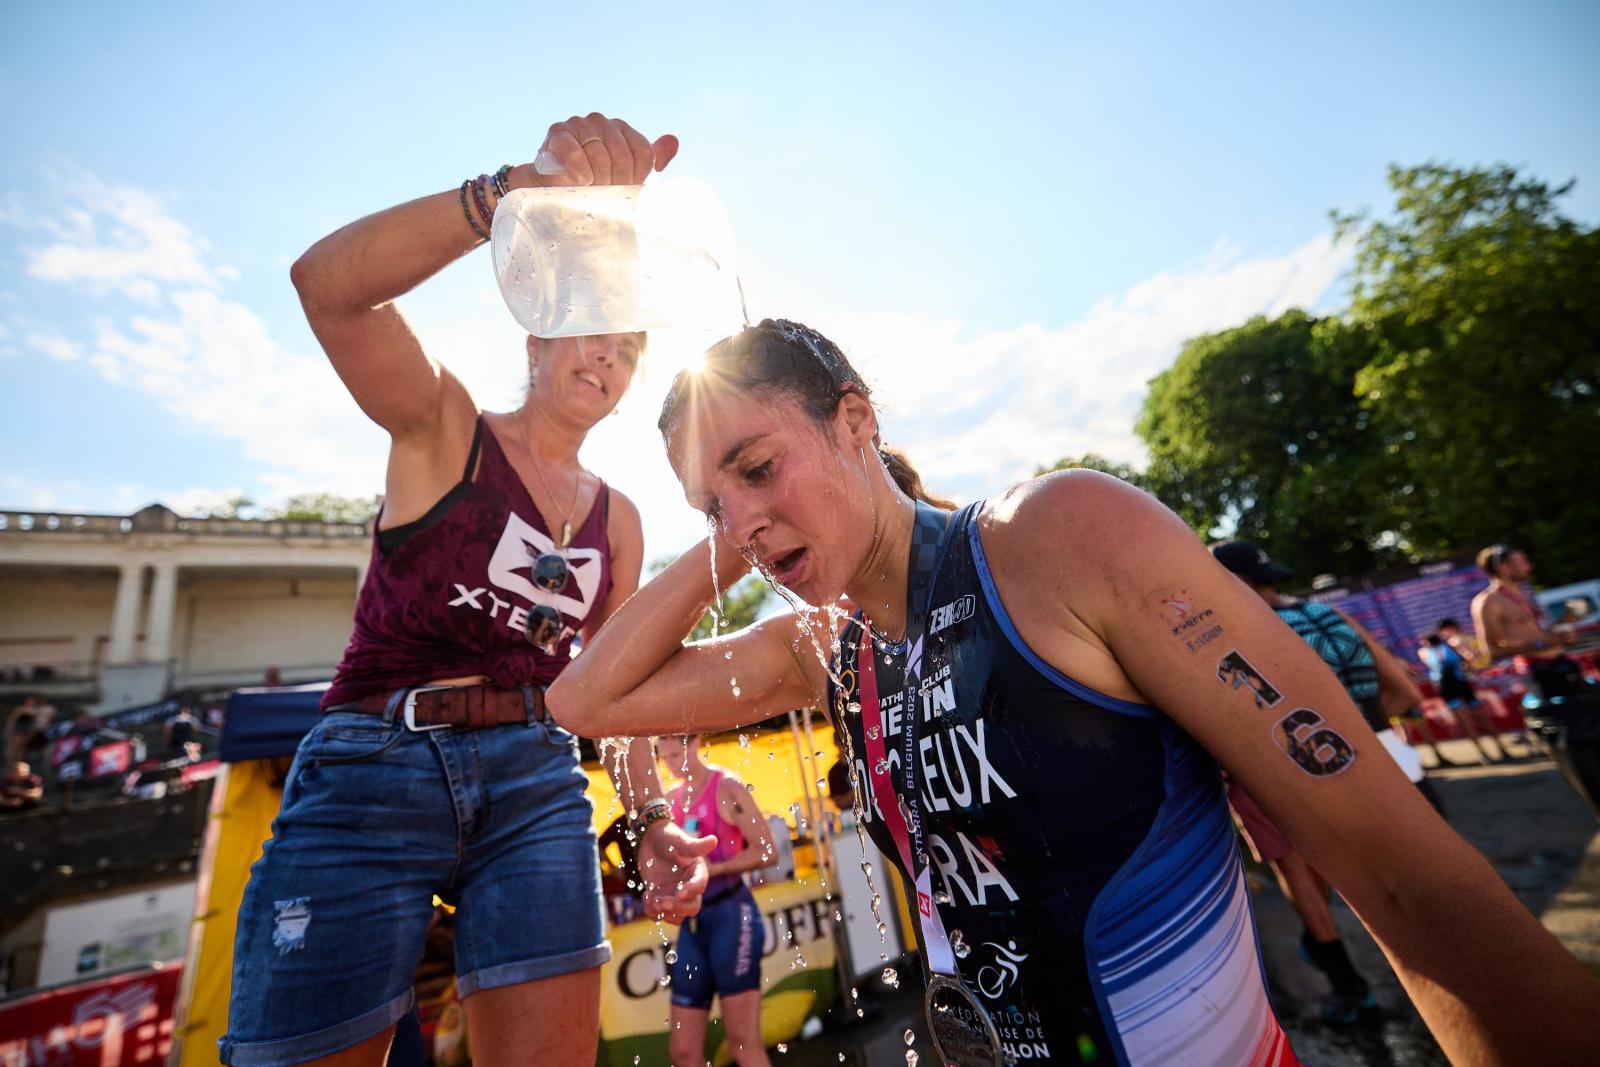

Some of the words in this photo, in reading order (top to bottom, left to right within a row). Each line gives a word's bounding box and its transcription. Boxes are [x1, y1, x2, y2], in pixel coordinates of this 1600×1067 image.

[448, 583, 576, 643] XTE
[921, 664, 951, 689] CLUB
[907, 686, 916, 721] 2023
[905, 725, 915, 790] BELGIUM
[928, 831, 1020, 907] RA
[1025, 1027, 1045, 1040] DE
